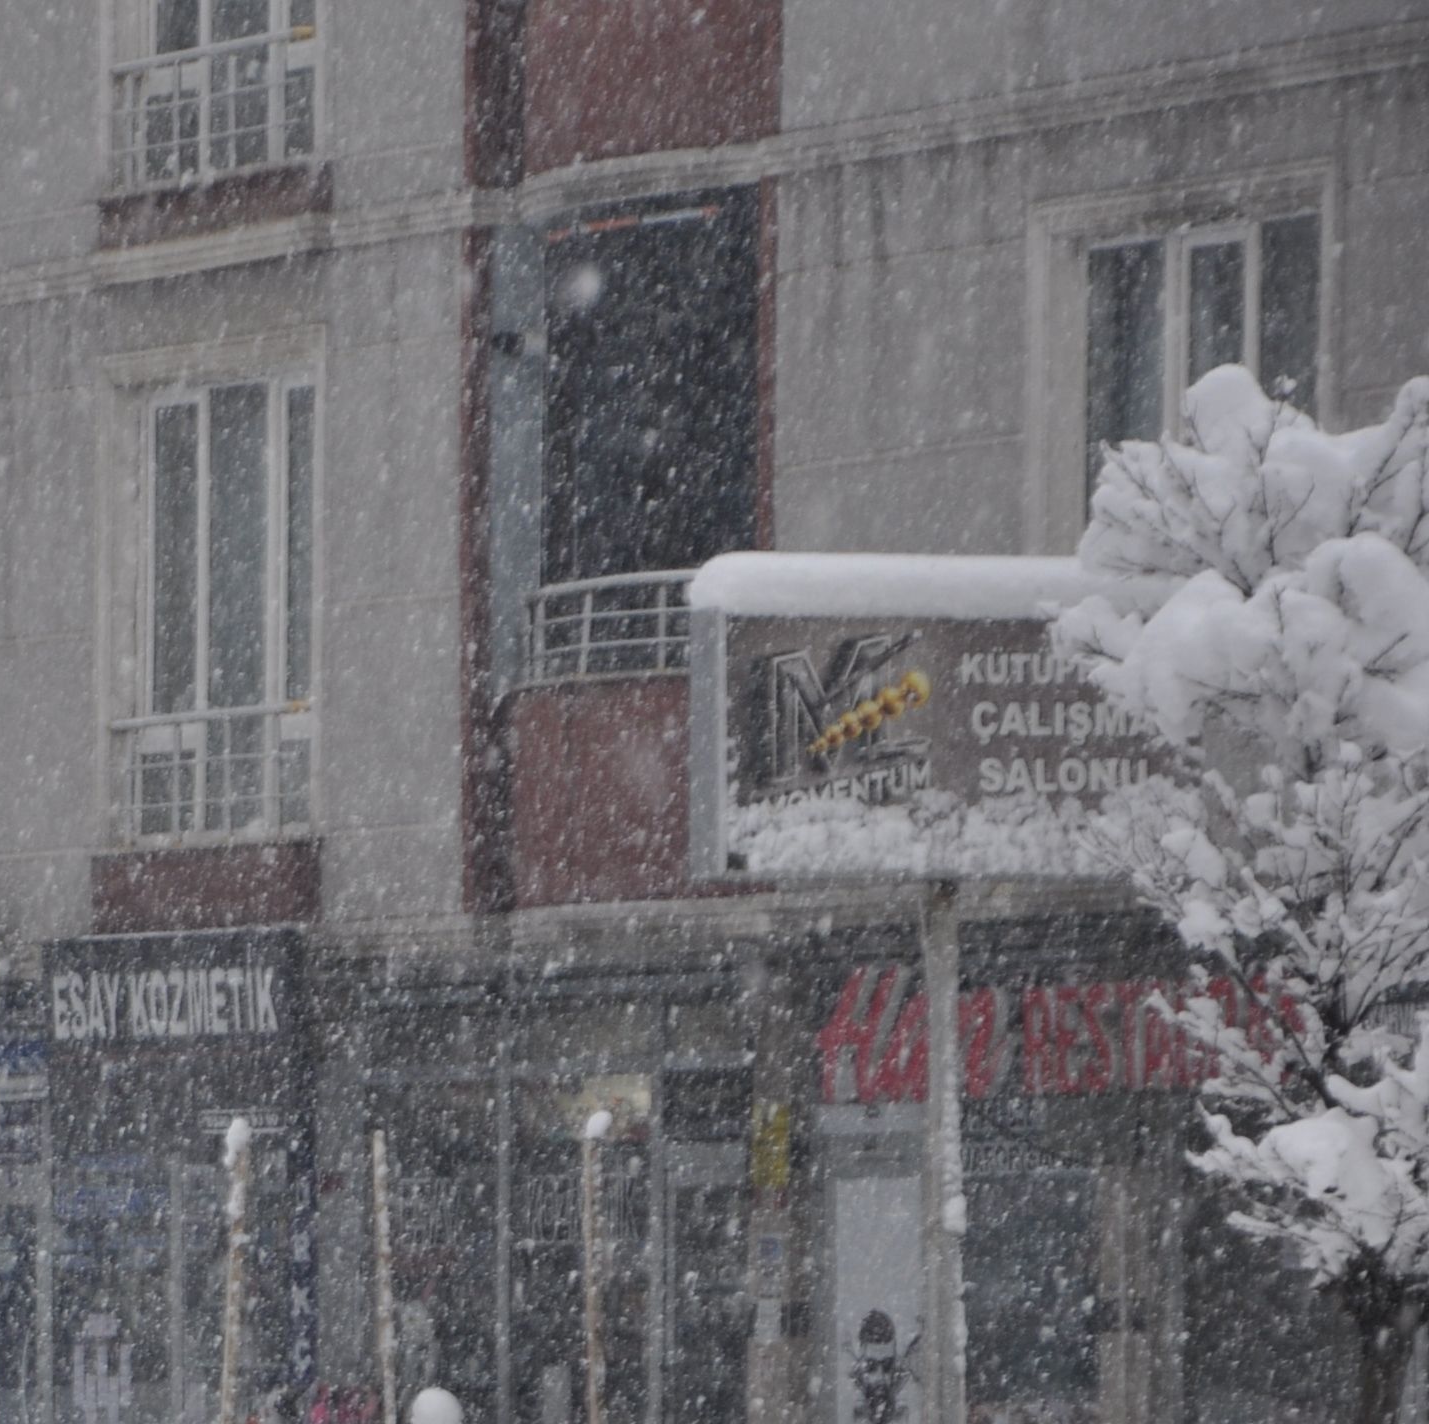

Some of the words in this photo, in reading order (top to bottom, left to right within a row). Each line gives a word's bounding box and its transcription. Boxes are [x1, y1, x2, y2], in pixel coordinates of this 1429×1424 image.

[960, 646, 1090, 685] KÜTÜP
[971, 701, 1158, 747] ÇALIŞMA
[978, 757, 1149, 793] SALONU
[53, 970, 120, 1041] ESAY
